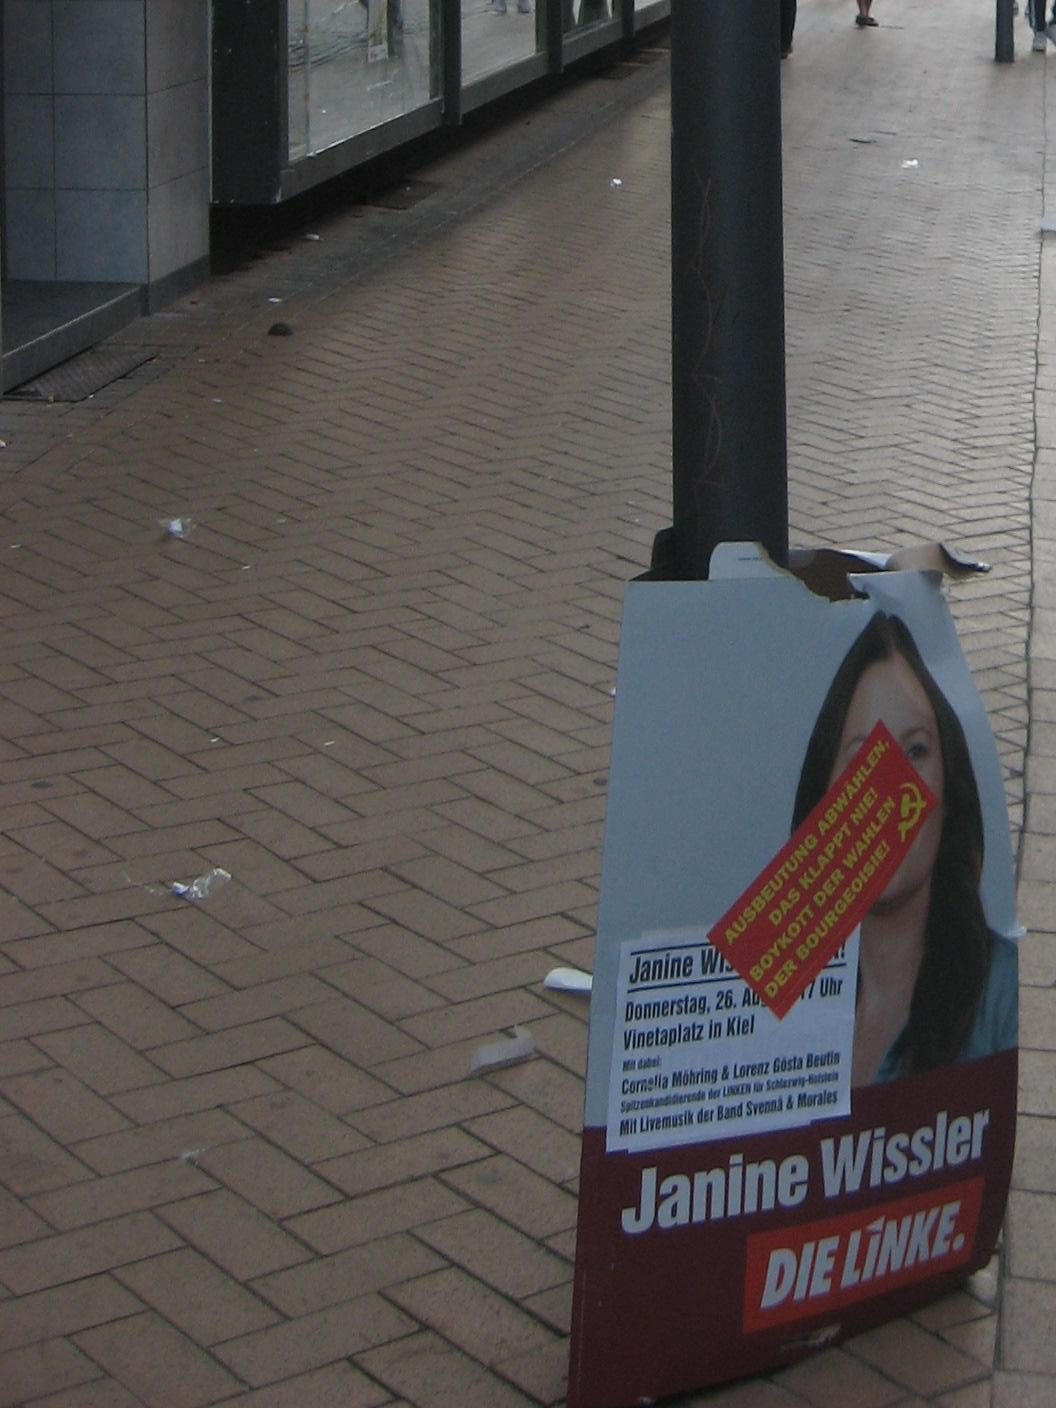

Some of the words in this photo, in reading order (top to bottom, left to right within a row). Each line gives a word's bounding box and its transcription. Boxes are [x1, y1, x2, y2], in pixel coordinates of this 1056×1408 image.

[724, 834, 818, 945] AUSBEUTUNG
[749, 903, 815, 983] BOYKOTT
[812, 870, 845, 908] DER
[842, 795, 897, 870] WAHLEN
[768, 888, 801, 928] DAS
[800, 824, 852, 890] KLAPPT
[851, 787, 879, 826] NIE!
[764, 962, 799, 998] DER
[795, 840, 892, 961] BOURGEOISIE!
[624, 994, 711, 1023] Donnerstag,
[715, 990, 738, 1011] 26.
[820, 976, 843, 998] Uhr
[629, 952, 694, 985] Janine
[623, 1023, 704, 1051] Vinetaplatz
[708, 1019, 722, 1039] in
[727, 1014, 756, 1036] Kiel
[622, 1073, 669, 1095] Cornelia
[672, 1068, 718, 1089] Möhring
[721, 1065, 730, 1081] &
[733, 1061, 770, 1079] Lorenz
[773, 1055, 803, 1073] Gösta
[806, 1051, 840, 1069] Beutin
[620, 1117, 637, 1137] Mit
[640, 1110, 694, 1133] Livemusik
[697, 1108, 715, 1124] der
[717, 1101, 743, 1121] Band
[786, 1095, 793, 1110] &
[797, 1090, 838, 1109] Morales
[620, 1152, 810, 1235] Janine
[819, 1109, 991, 1200] Wissler
[760, 1235, 840, 1311] DIE
